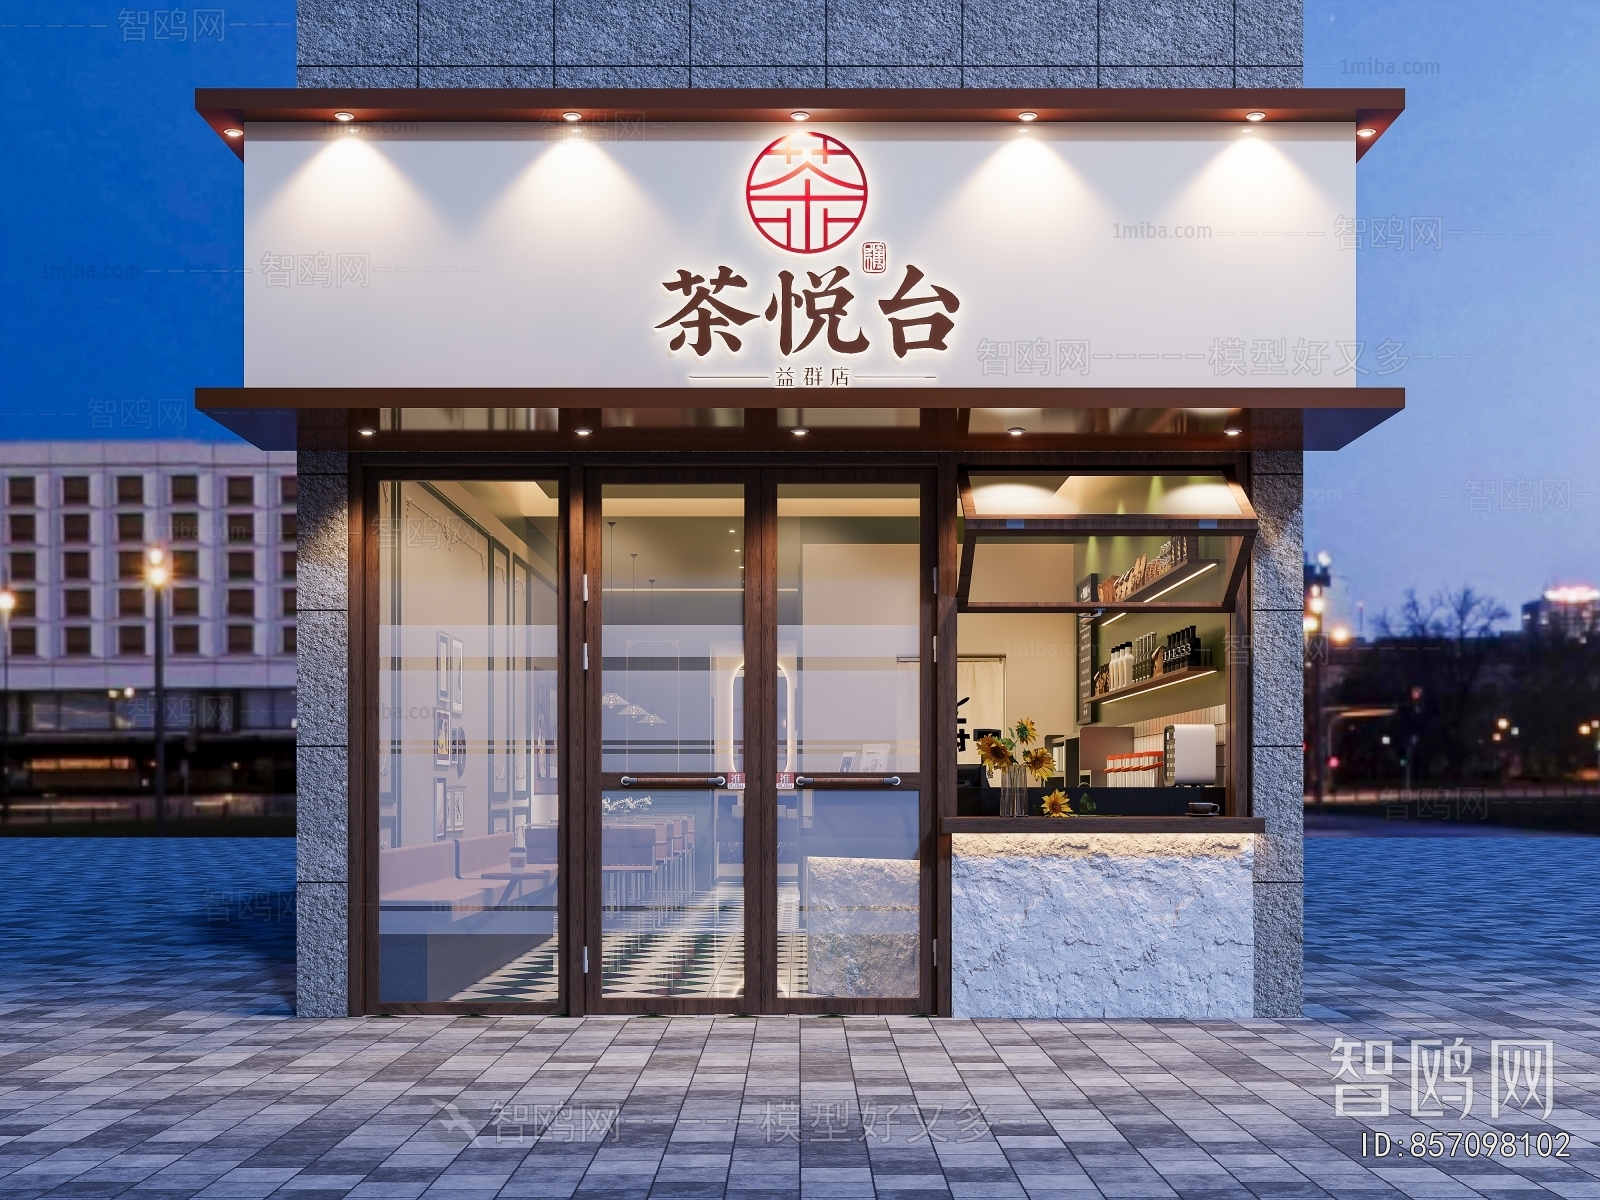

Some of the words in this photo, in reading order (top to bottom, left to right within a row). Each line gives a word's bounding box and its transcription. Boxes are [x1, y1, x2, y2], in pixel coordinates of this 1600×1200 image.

[654, 265, 960, 358] 茶悦台
[774, 366, 850, 387] 益群店
[731, 773, 741, 783] 推
[780, 773, 790, 783] 推
